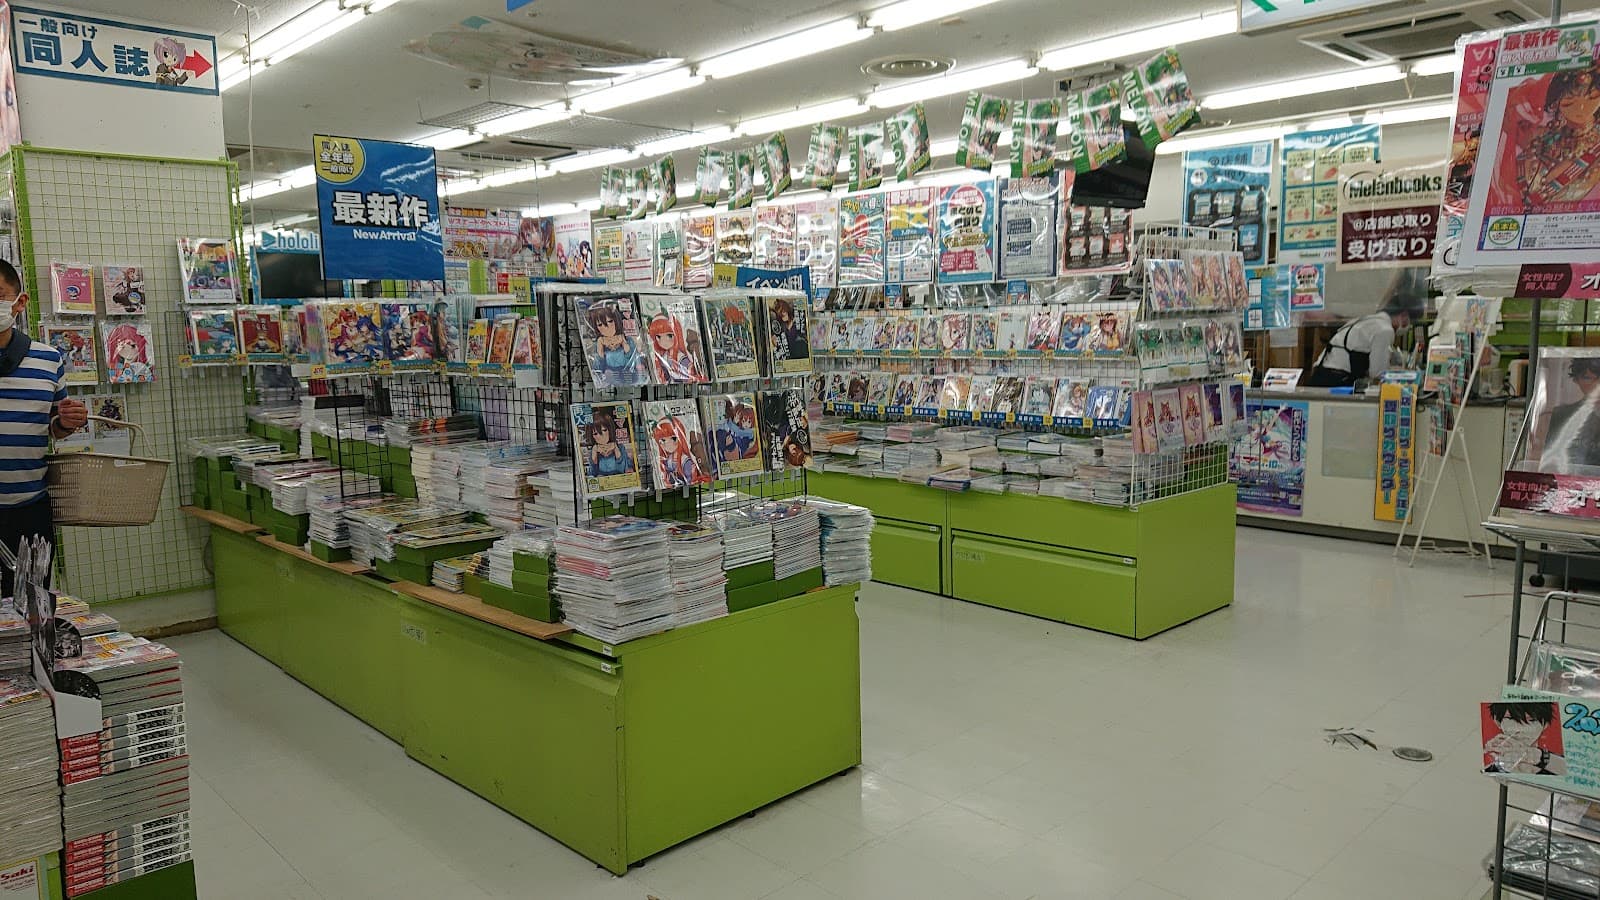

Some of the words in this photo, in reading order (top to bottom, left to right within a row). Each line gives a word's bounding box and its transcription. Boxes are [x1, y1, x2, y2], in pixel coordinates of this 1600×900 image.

[19, 18, 98, 40] 一般向け
[1505, 29, 1561, 50] 最新作
[22, 31, 151, 77] 同人誌
[1122, 71, 1152, 136] MELON
[1010, 100, 1024, 163] MELON
[1066, 94, 1084, 159] MELON
[320, 151, 354, 164] 全年齢
[333, 191, 429, 228] 最新作
[1522, 272, 1564, 283] 女性向け
[1525, 282, 1557, 291] 同人誌
[1, 866, 34, 880] Saki
